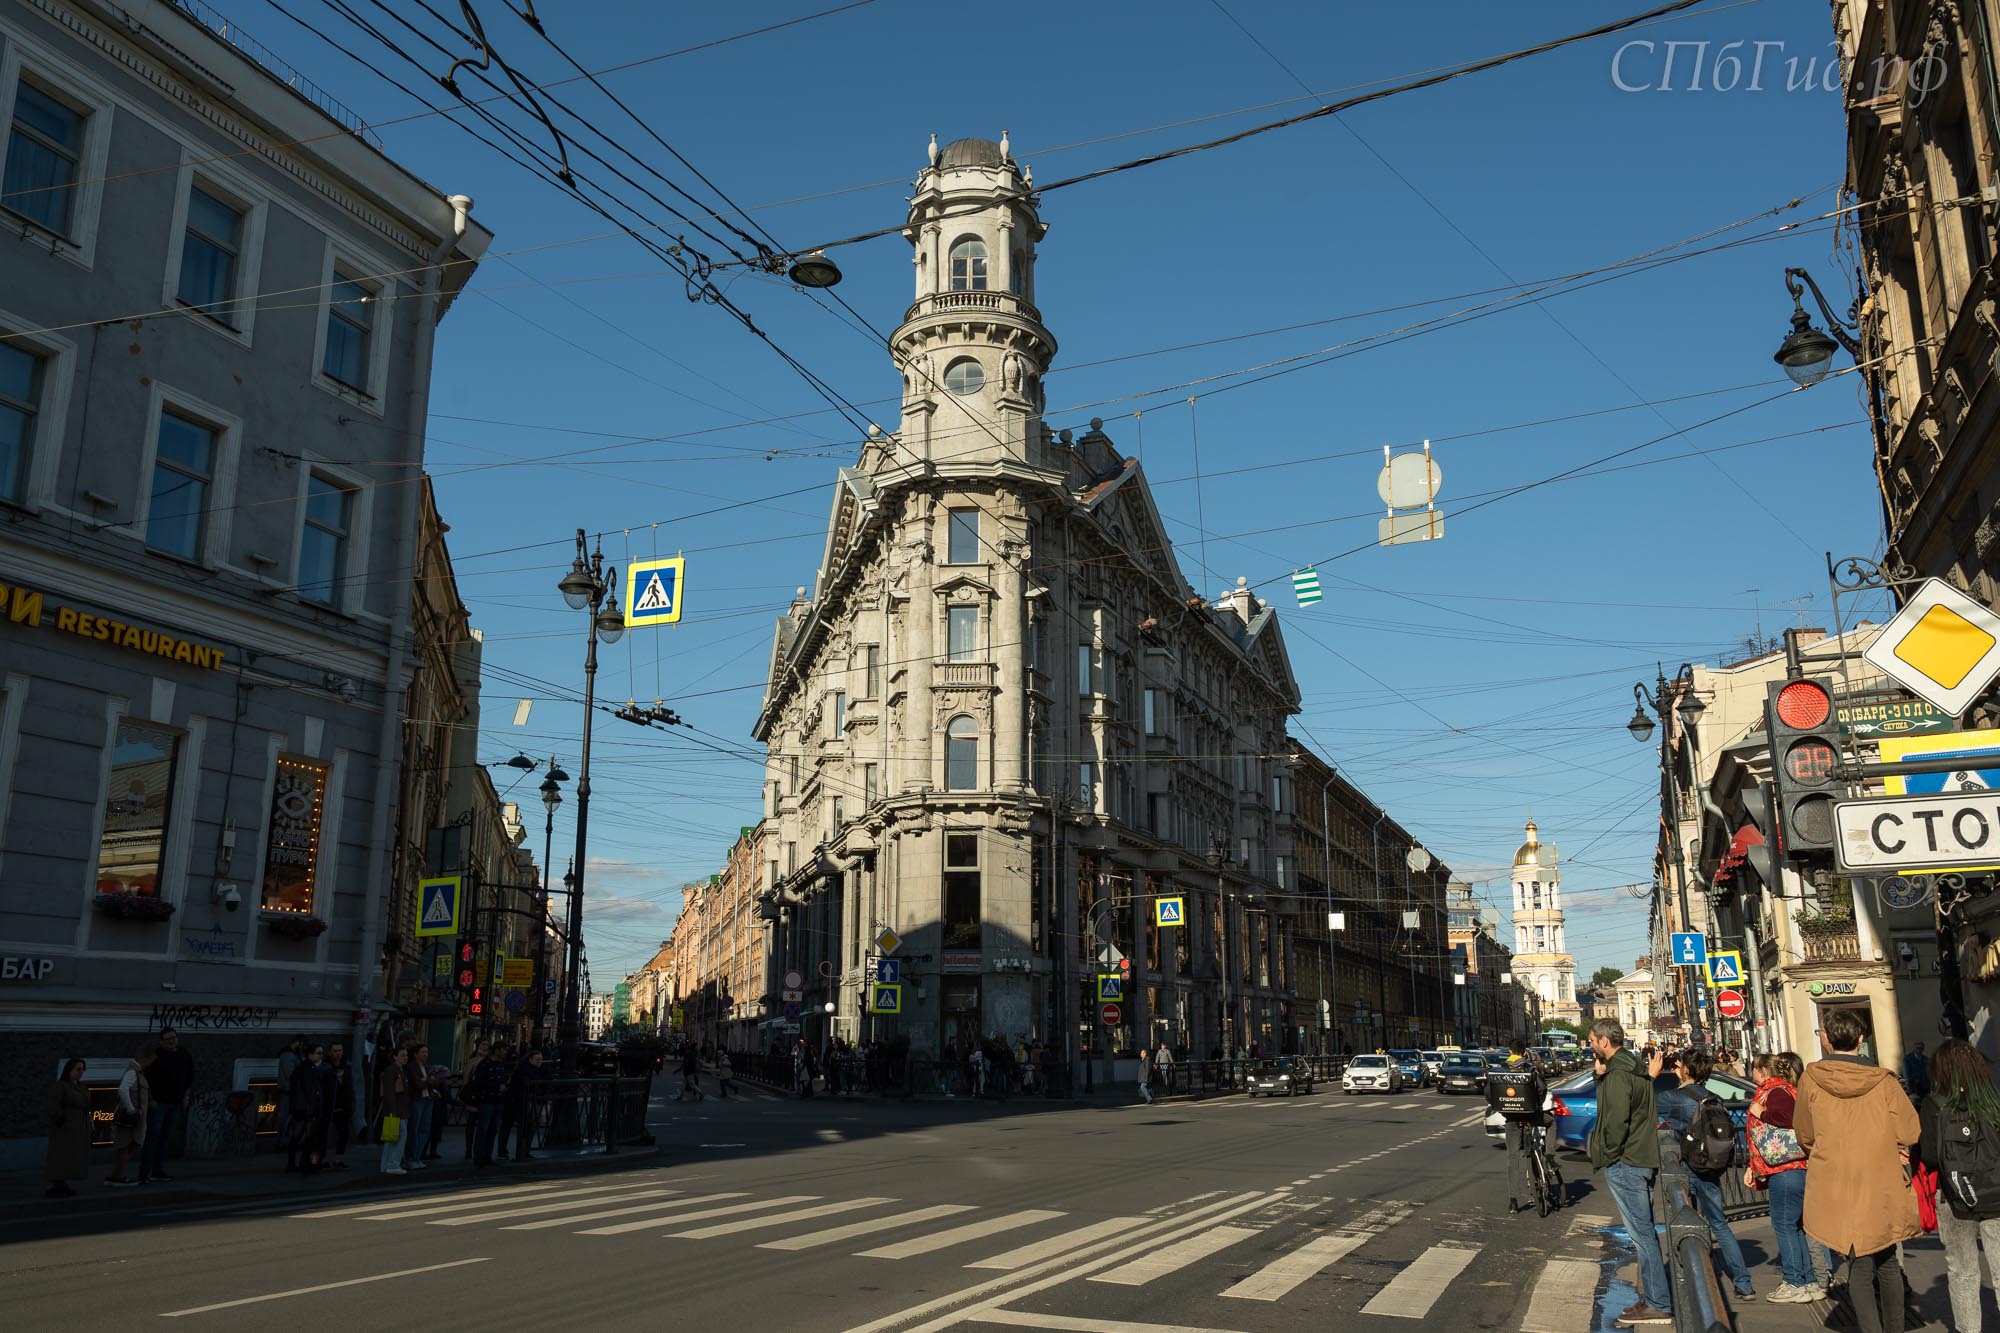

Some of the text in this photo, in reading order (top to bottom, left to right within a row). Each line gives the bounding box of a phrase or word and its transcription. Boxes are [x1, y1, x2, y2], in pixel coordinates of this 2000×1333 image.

[58, 607, 225, 672] RESTAURANT
[1893, 702, 1942, 718] ЗОЛО
[1883, 722, 1909, 731] СКУПКА
[1871, 806, 2000, 855] СТО
[1, 957, 55, 980] БАР
[1825, 983, 1856, 994] DAILY
[93, 1109, 115, 1121] Pizza
